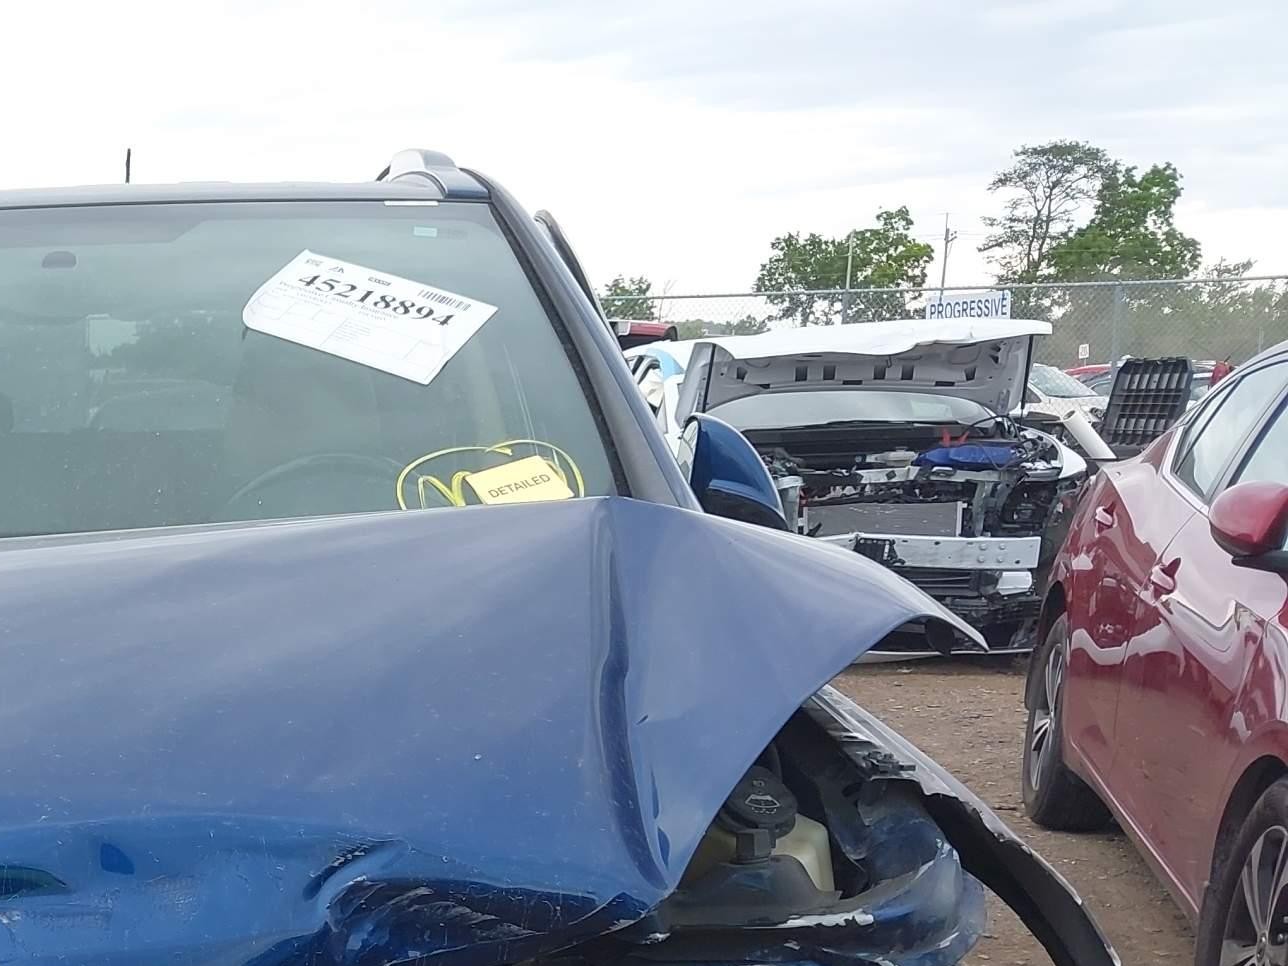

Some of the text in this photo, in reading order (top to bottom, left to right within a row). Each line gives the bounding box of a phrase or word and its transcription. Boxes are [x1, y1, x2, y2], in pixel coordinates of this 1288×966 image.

[297, 274, 456, 326] 45218894
[929, 297, 1007, 320] PROGRESSIVE
[487, 474, 551, 498] DETAILED
